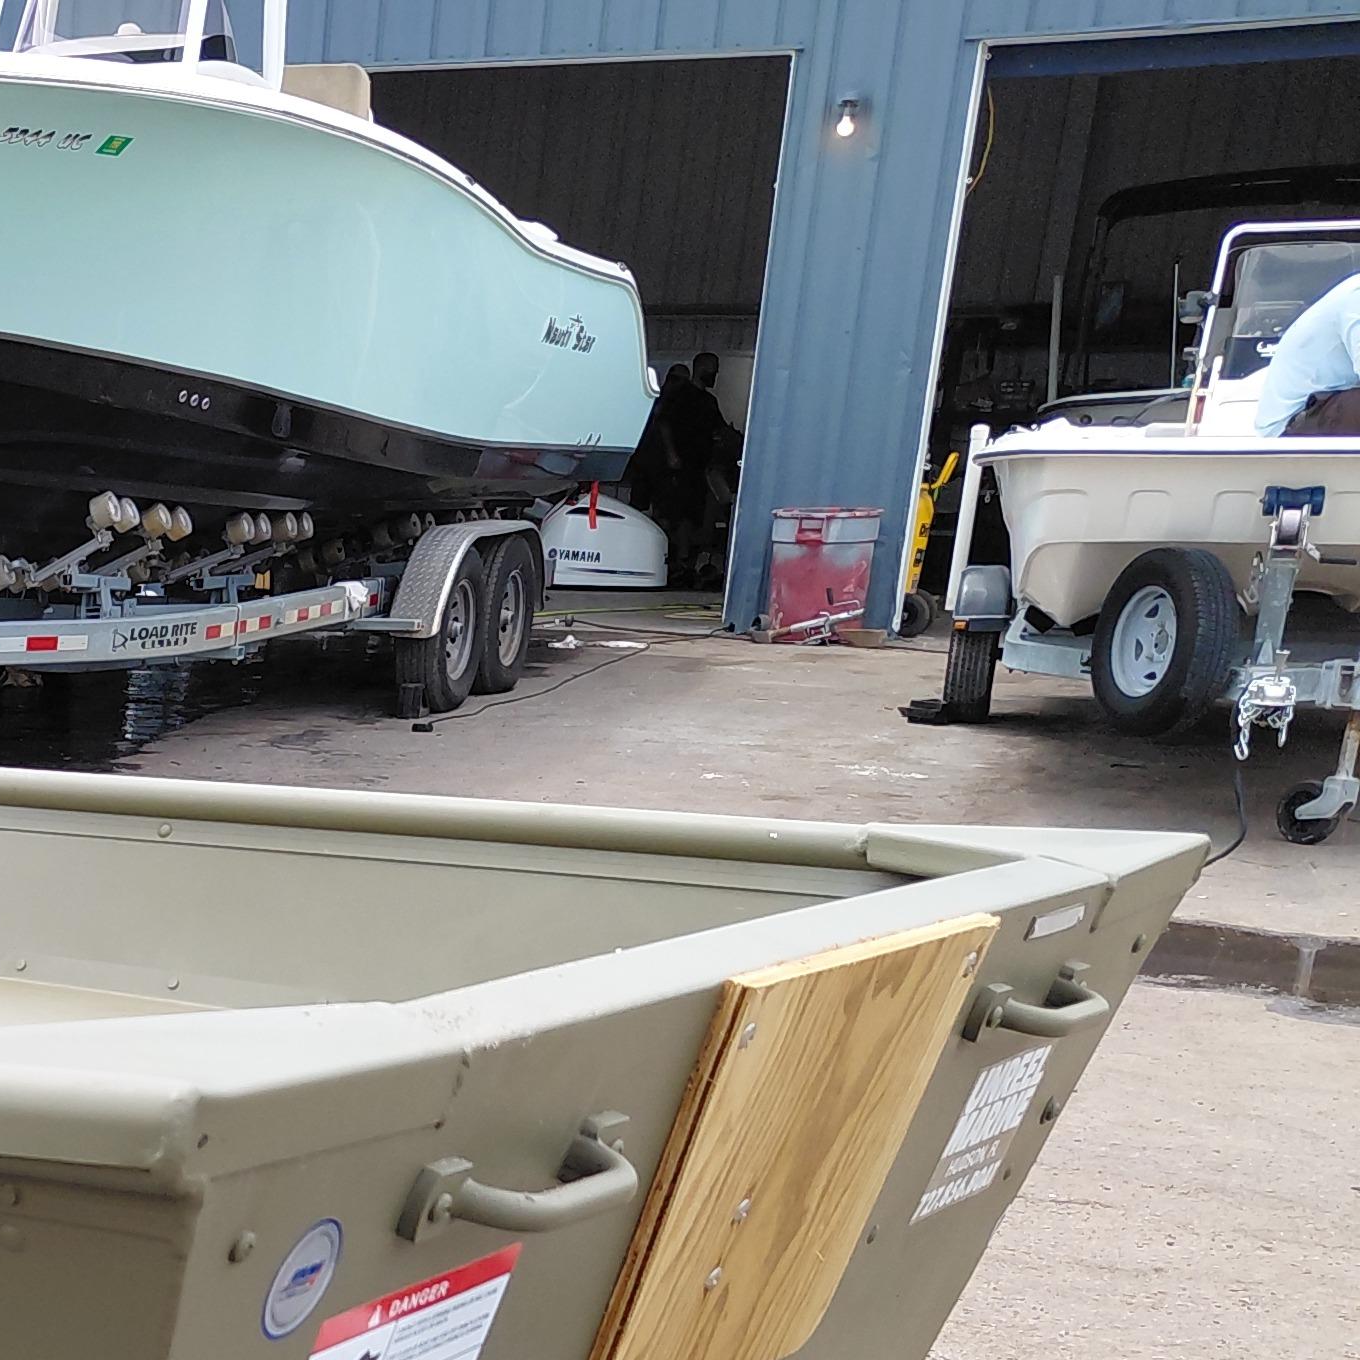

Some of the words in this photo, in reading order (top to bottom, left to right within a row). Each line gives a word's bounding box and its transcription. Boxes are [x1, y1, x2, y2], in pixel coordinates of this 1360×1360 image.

[559, 548, 601, 563] YAMAHA
[129, 625, 169, 642] LOAD
[171, 622, 198, 638] RITE
[965, 1045, 1053, 1115] UNREEL
[941, 1084, 1039, 1159] MARINE
[388, 1280, 451, 1319] DANGER
